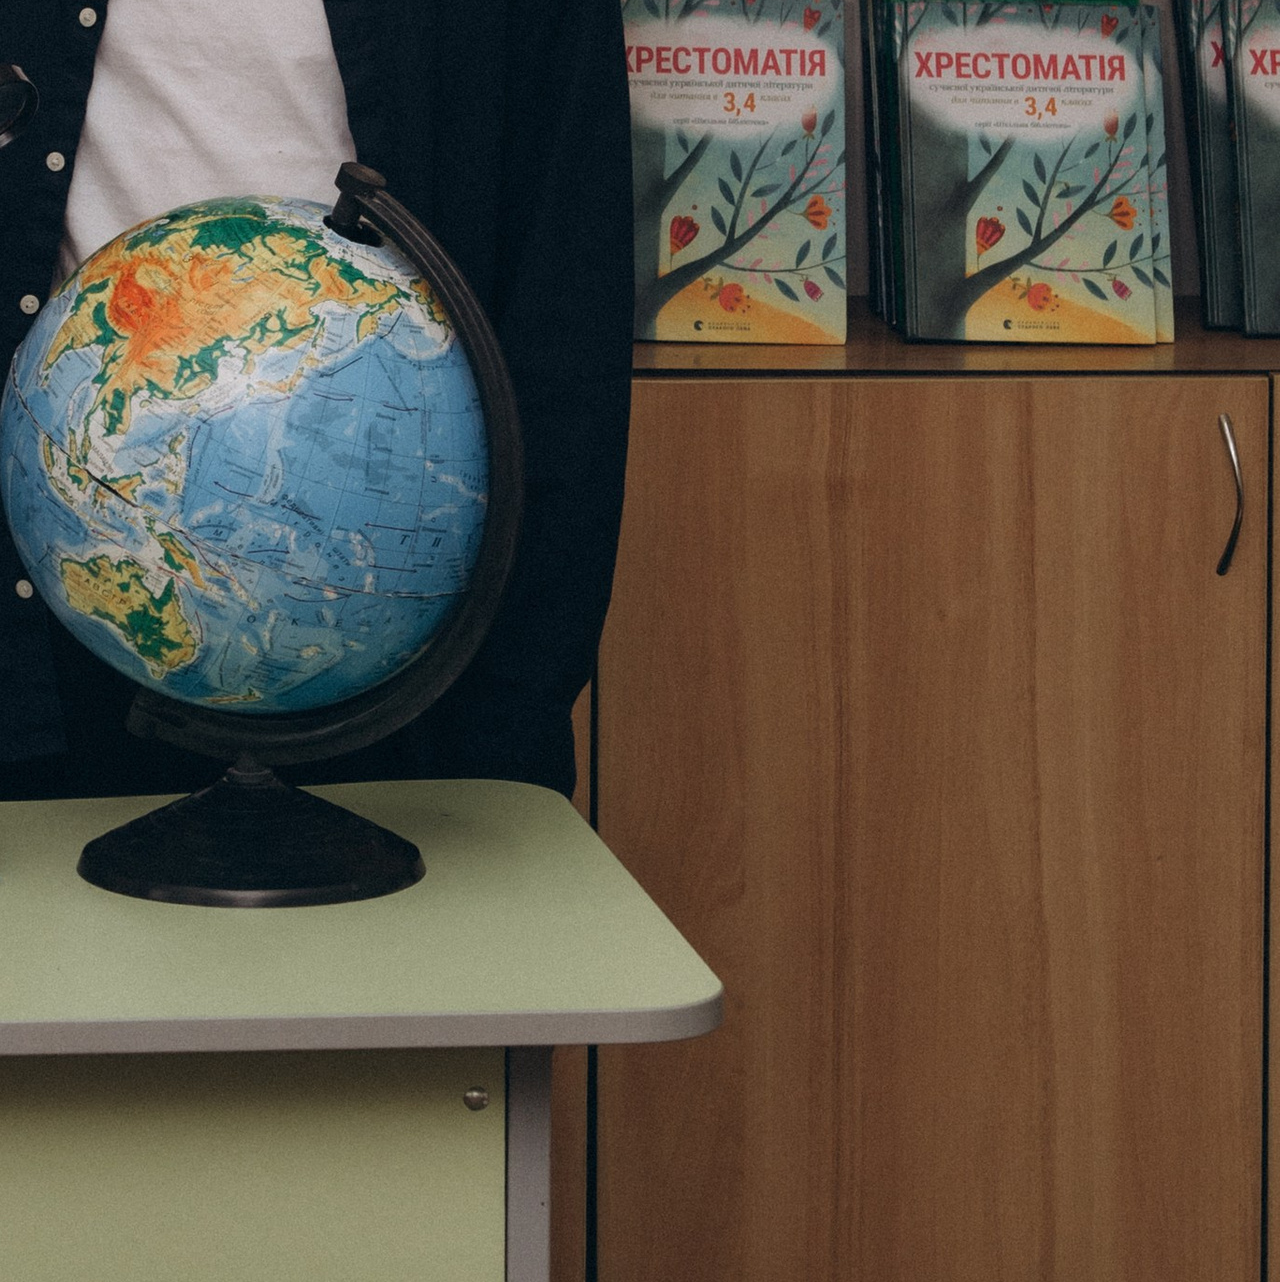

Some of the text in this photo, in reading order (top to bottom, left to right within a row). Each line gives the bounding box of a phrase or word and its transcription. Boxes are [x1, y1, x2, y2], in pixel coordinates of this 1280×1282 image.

[914, 51, 1126, 81] ХРЕСТОМАТІЯ
[669, 78, 724, 90] української
[763, 80, 814, 93] літератури
[970, 84, 1024, 95] української
[1063, 86, 1114, 97] літератури
